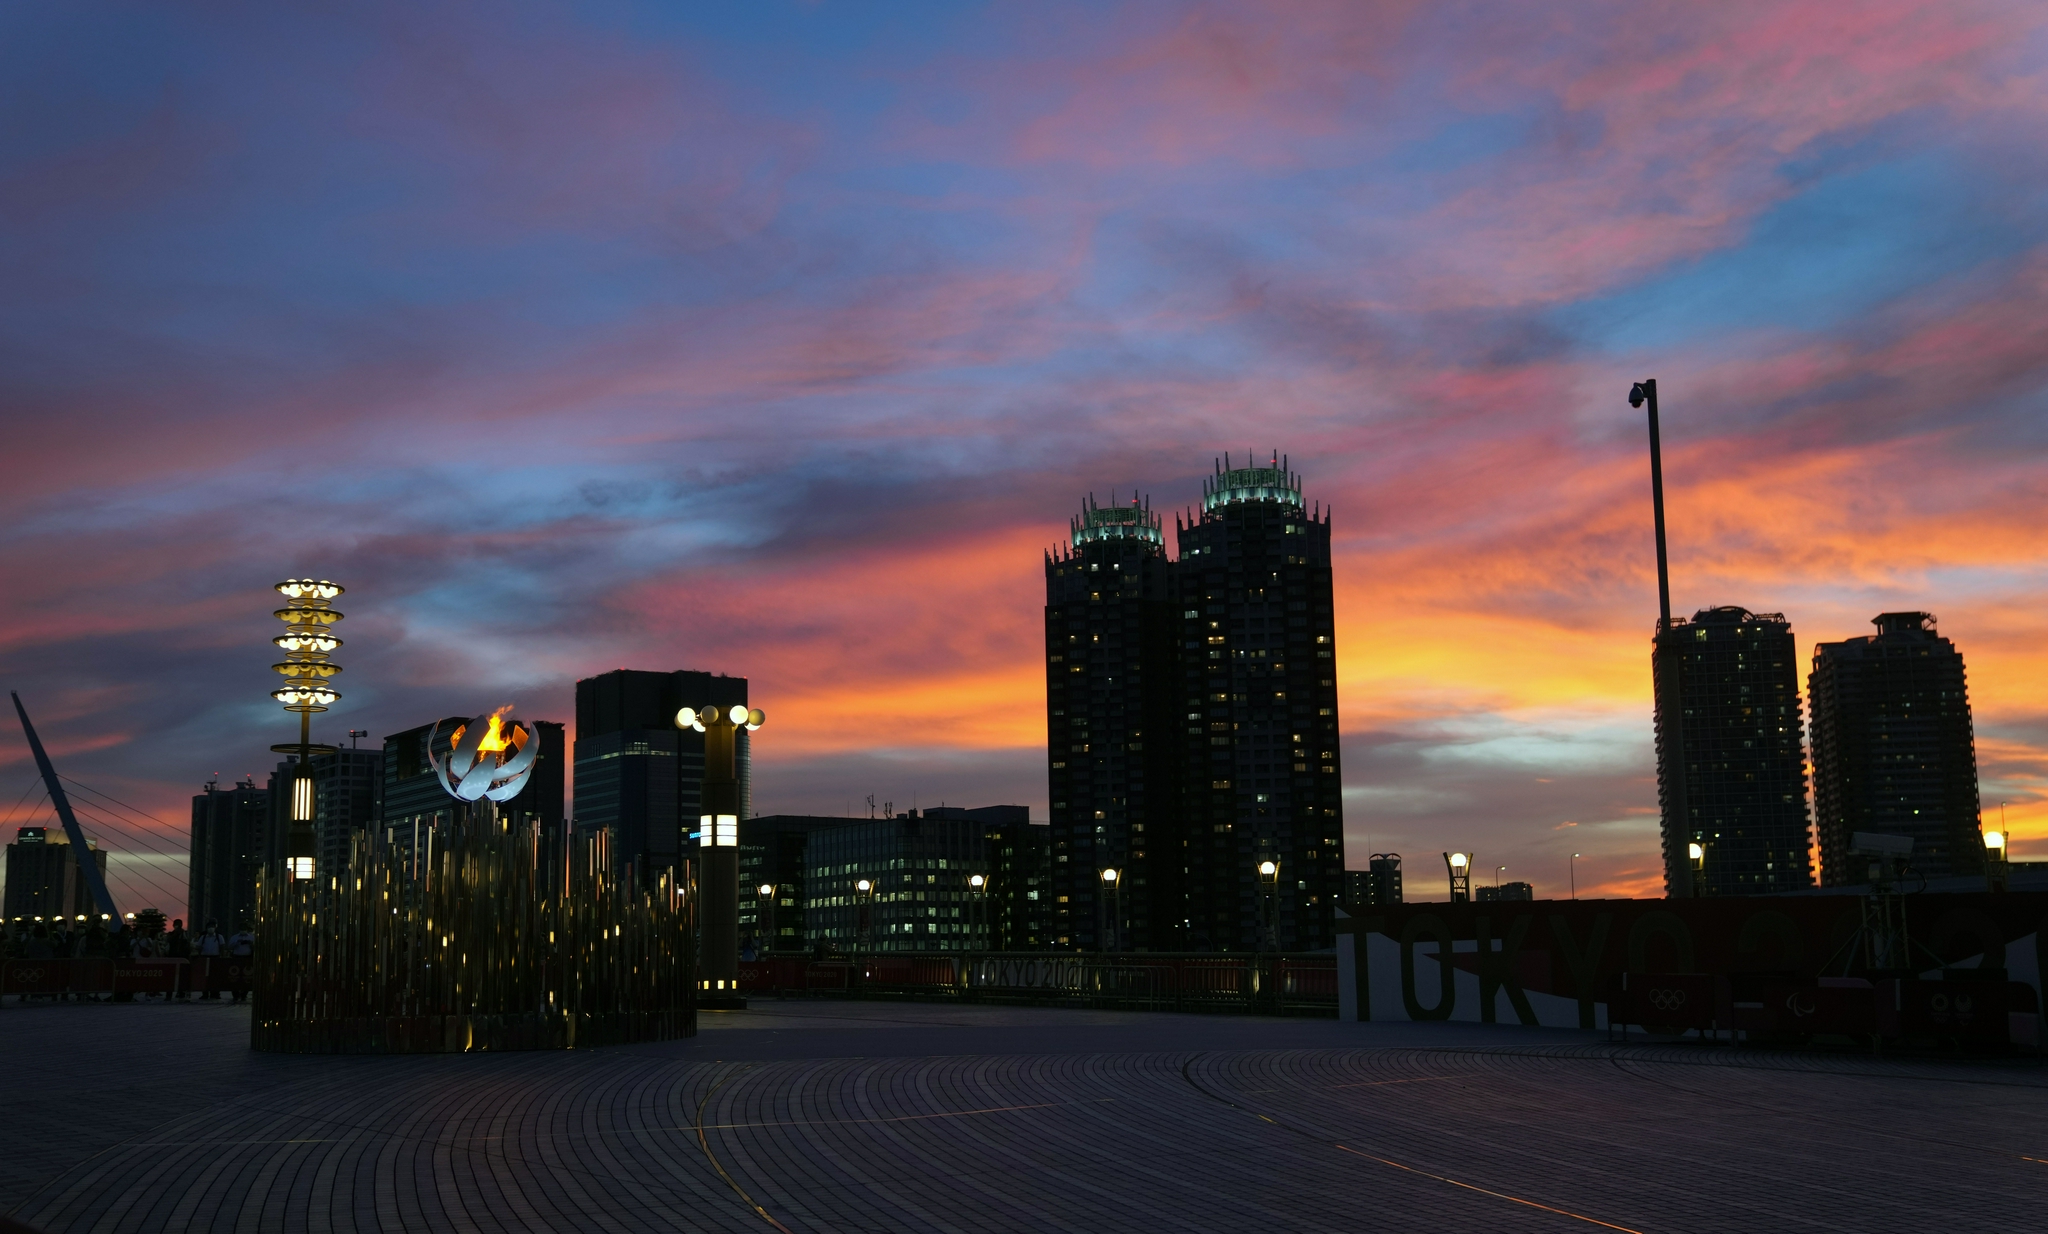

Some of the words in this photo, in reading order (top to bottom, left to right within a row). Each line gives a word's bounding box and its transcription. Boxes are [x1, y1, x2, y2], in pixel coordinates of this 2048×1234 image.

[115, 969, 142, 977] TOKYO
[143, 969, 163, 977] 2020
[804, 970, 823, 978] TOKYO
[971, 959, 1036, 988] TOKYO
[1335, 909, 1696, 1036] TOKYO
